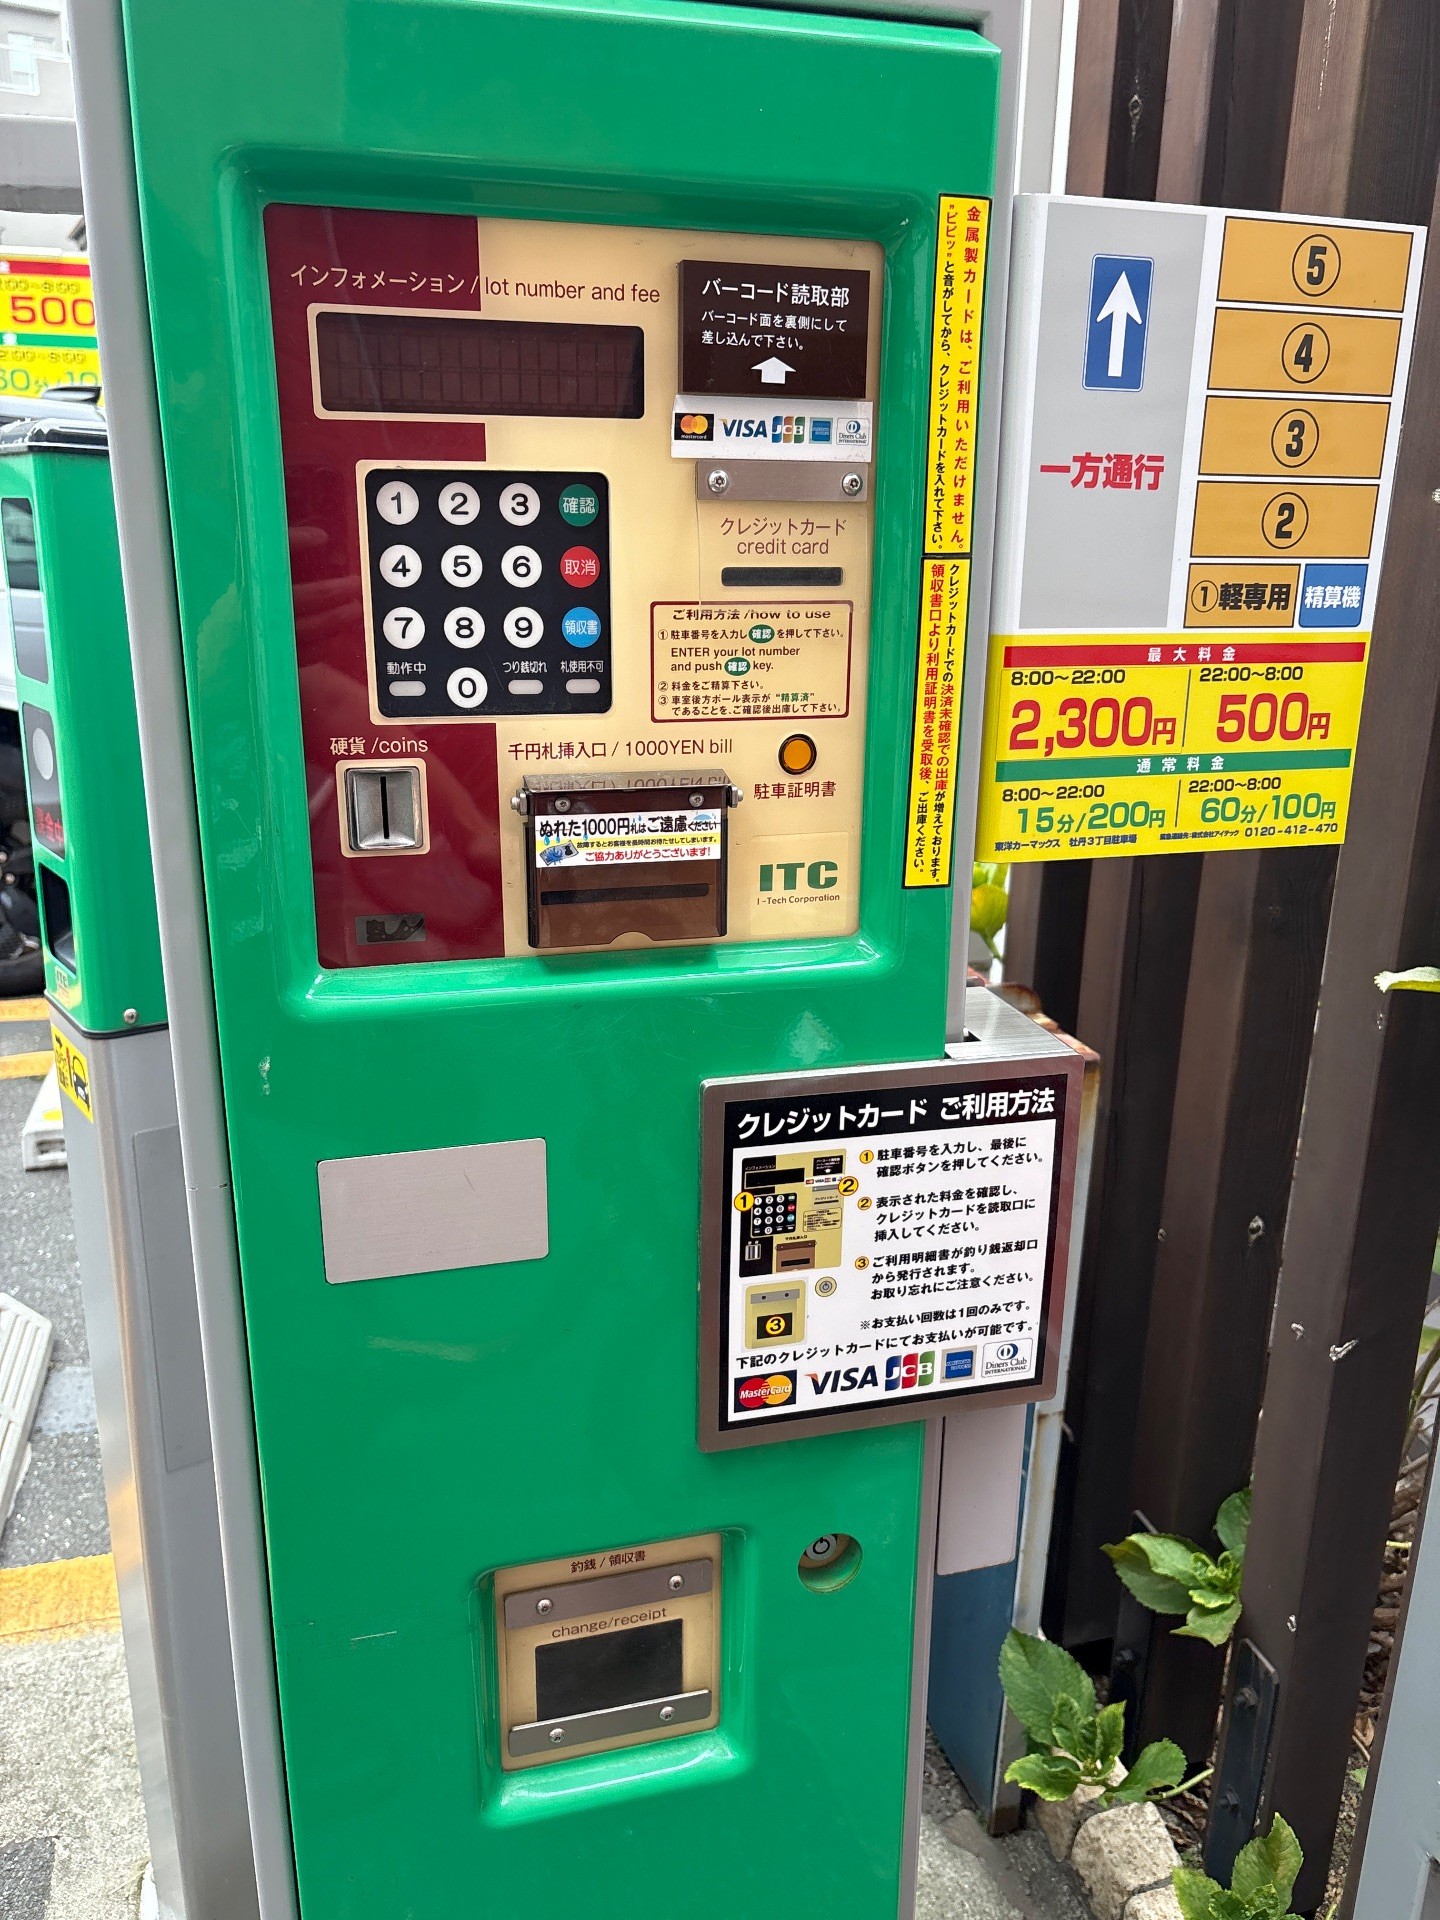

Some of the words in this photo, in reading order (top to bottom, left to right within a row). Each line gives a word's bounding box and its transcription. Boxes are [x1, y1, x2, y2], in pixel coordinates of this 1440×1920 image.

[485, 277, 509, 296] lot
[515, 278, 585, 299] number
[591, 283, 624, 301] and
[631, 284, 660, 303] fee
[702, 277, 849, 308] バーコード読取部
[701, 310, 847, 332] バーコード面を裏側にして
[701, 330, 804, 350] 差し込んで下さい。
[719, 418, 768, 438] VISA
[1040, 452, 1165, 491] 一方通行
[390, 491, 402, 515] 1
[450, 492, 470, 516] 2
[511, 493, 529, 516] 3
[562, 497, 596, 515] 確認
[720, 517, 848, 537] クレジットカード
[737, 538, 787, 555] credit
[792, 539, 830, 555] card
[391, 555, 411, 578] 4
[453, 555, 471, 578] 5
[512, 555, 531, 578] 6
[564, 559, 596, 576] 取消
[1304, 585, 1361, 609] 精算機
[672, 608, 741, 621] ご利用方法
[805, 609, 831, 619] use
[394, 617, 413, 639] 7
[455, 617, 475, 639] 8
[514, 616, 533, 639] 9
[564, 620, 598, 635] 領収書
[670, 629, 747, 640] 駐車番号を入力し
[751, 628, 772, 639] 確認
[776, 627, 844, 639] を押して下さい。
[671, 647, 710, 658] ENTER
[713, 648, 739, 660] your
[741, 647, 757, 657] lot
[758, 646, 800, 657] number
[1147, 646, 1236, 663] 最大料金
[386, 661, 427, 675] 動作中
[502, 660, 548, 674] つり銭切れ
[560, 660, 604, 673] 札使用不可
[671, 661, 691, 672] and
[694, 661, 722, 673] push
[727, 661, 748, 672] 確認
[752, 660, 774, 672] key.
[457, 677, 477, 699] 0
[671, 680, 764, 691] 料金をご精算下さい。
[672, 704, 841, 716] であることを、ご確認後出庫して下さい。
[1216, 692, 1331, 743] 500円
[1009, 696, 1177, 757] 2,300円
[330, 737, 366, 756] 硬貨
[508, 741, 607, 761] 千円札挿入口
[625, 739, 704, 757] 1000YEN
[709, 739, 733, 755] bill
[1136, 755, 1224, 774] 通常料金
[754, 780, 837, 800] 駐車証明書
[1017, 800, 1166, 834] 15分/200円
[1200, 793, 1336, 824] 60分/100円
[1245, 823, 1338, 837] 0120-412-470
[994, 839, 1060, 851] 東洋カーマックス
[759, 861, 838, 892] ITC
[788, 893, 840, 904] Corporation
[738, 1098, 928, 1140] クレジットカード
[940, 1087, 1055, 1121] ご利用方法
[877, 1136, 1027, 1162] 駐車番号を入力し、最後に
[876, 1152, 1044, 1178] 確認ボタンを押してください。
[875, 1185, 1019, 1209] 表示された料金を確認し、
[876, 1198, 1036, 1225] クレジットカードを読取口に
[874, 1222, 980, 1243] 挿入してください。
[872, 1239, 1038, 1268] ご利用明細書が釣り銭返却口
[872, 1262, 976, 1284] から発行されます。
[870, 1272, 1034, 1300] お取り忘れにご注意ください。
[736, 1320, 1033, 1370] 下記のクレジットカードにてお支払いが可能です。
[985, 1361, 1009, 1370] Diners
[1010, 1356, 1027, 1366] Club
[739, 1383, 791, 1399] MasterCard
[804, 1365, 879, 1395] VISA
[570, 1558, 597, 1574] 釣銭
[608, 1549, 646, 1566] 領収書
[551, 1607, 667, 1639] change/receipt
